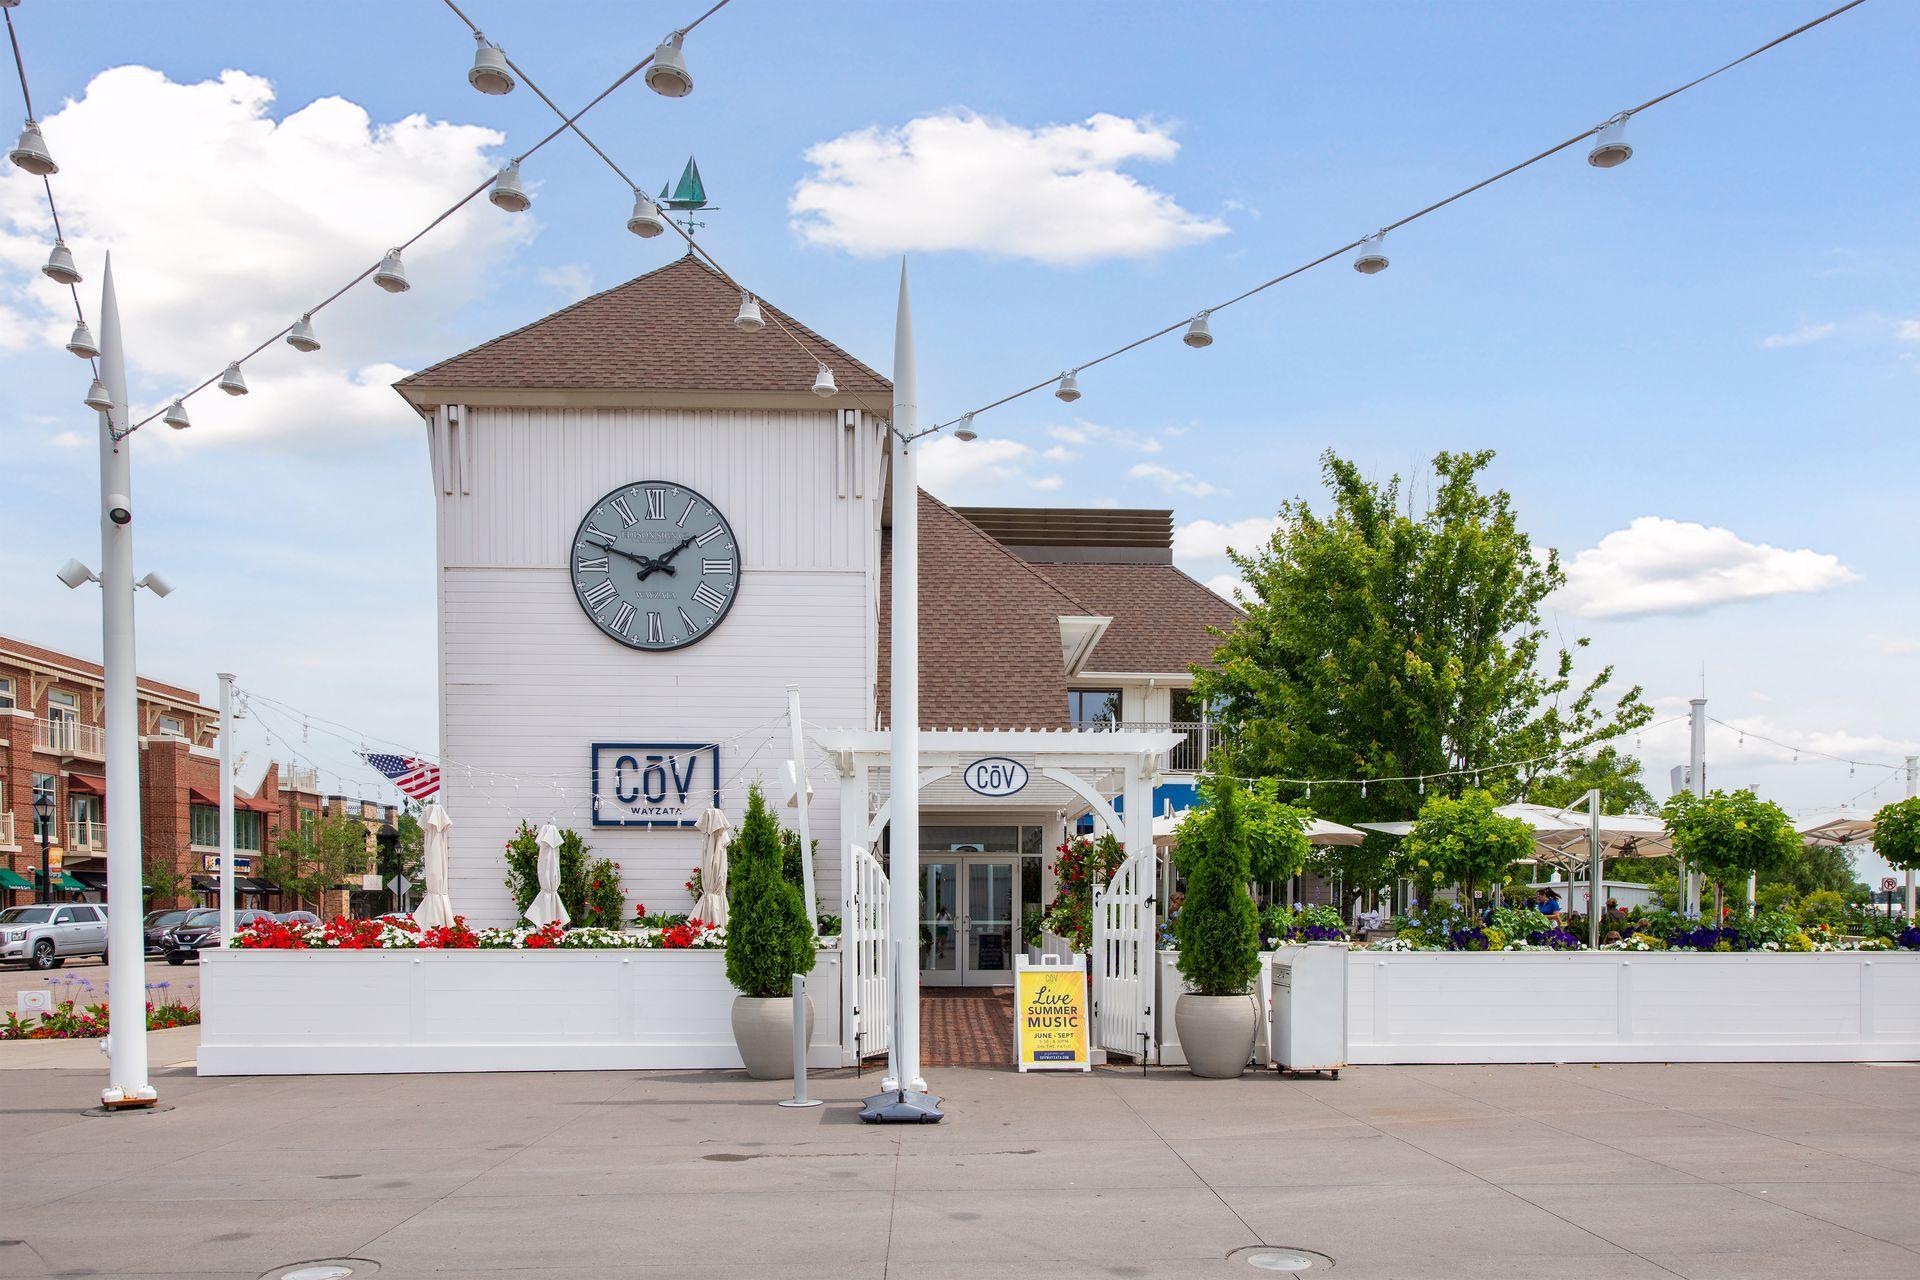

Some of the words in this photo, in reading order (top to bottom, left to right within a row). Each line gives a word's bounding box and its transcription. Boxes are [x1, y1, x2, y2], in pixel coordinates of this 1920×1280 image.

[610, 495, 639, 529] XI
[645, 488, 667, 520] XII
[702, 558, 733, 575] III
[631, 807, 682, 815] WAYZATA
[1032, 985, 1074, 1005] Live
[1028, 1006, 1078, 1015] SUMMER
[1028, 1016, 1079, 1028] MUSIC
